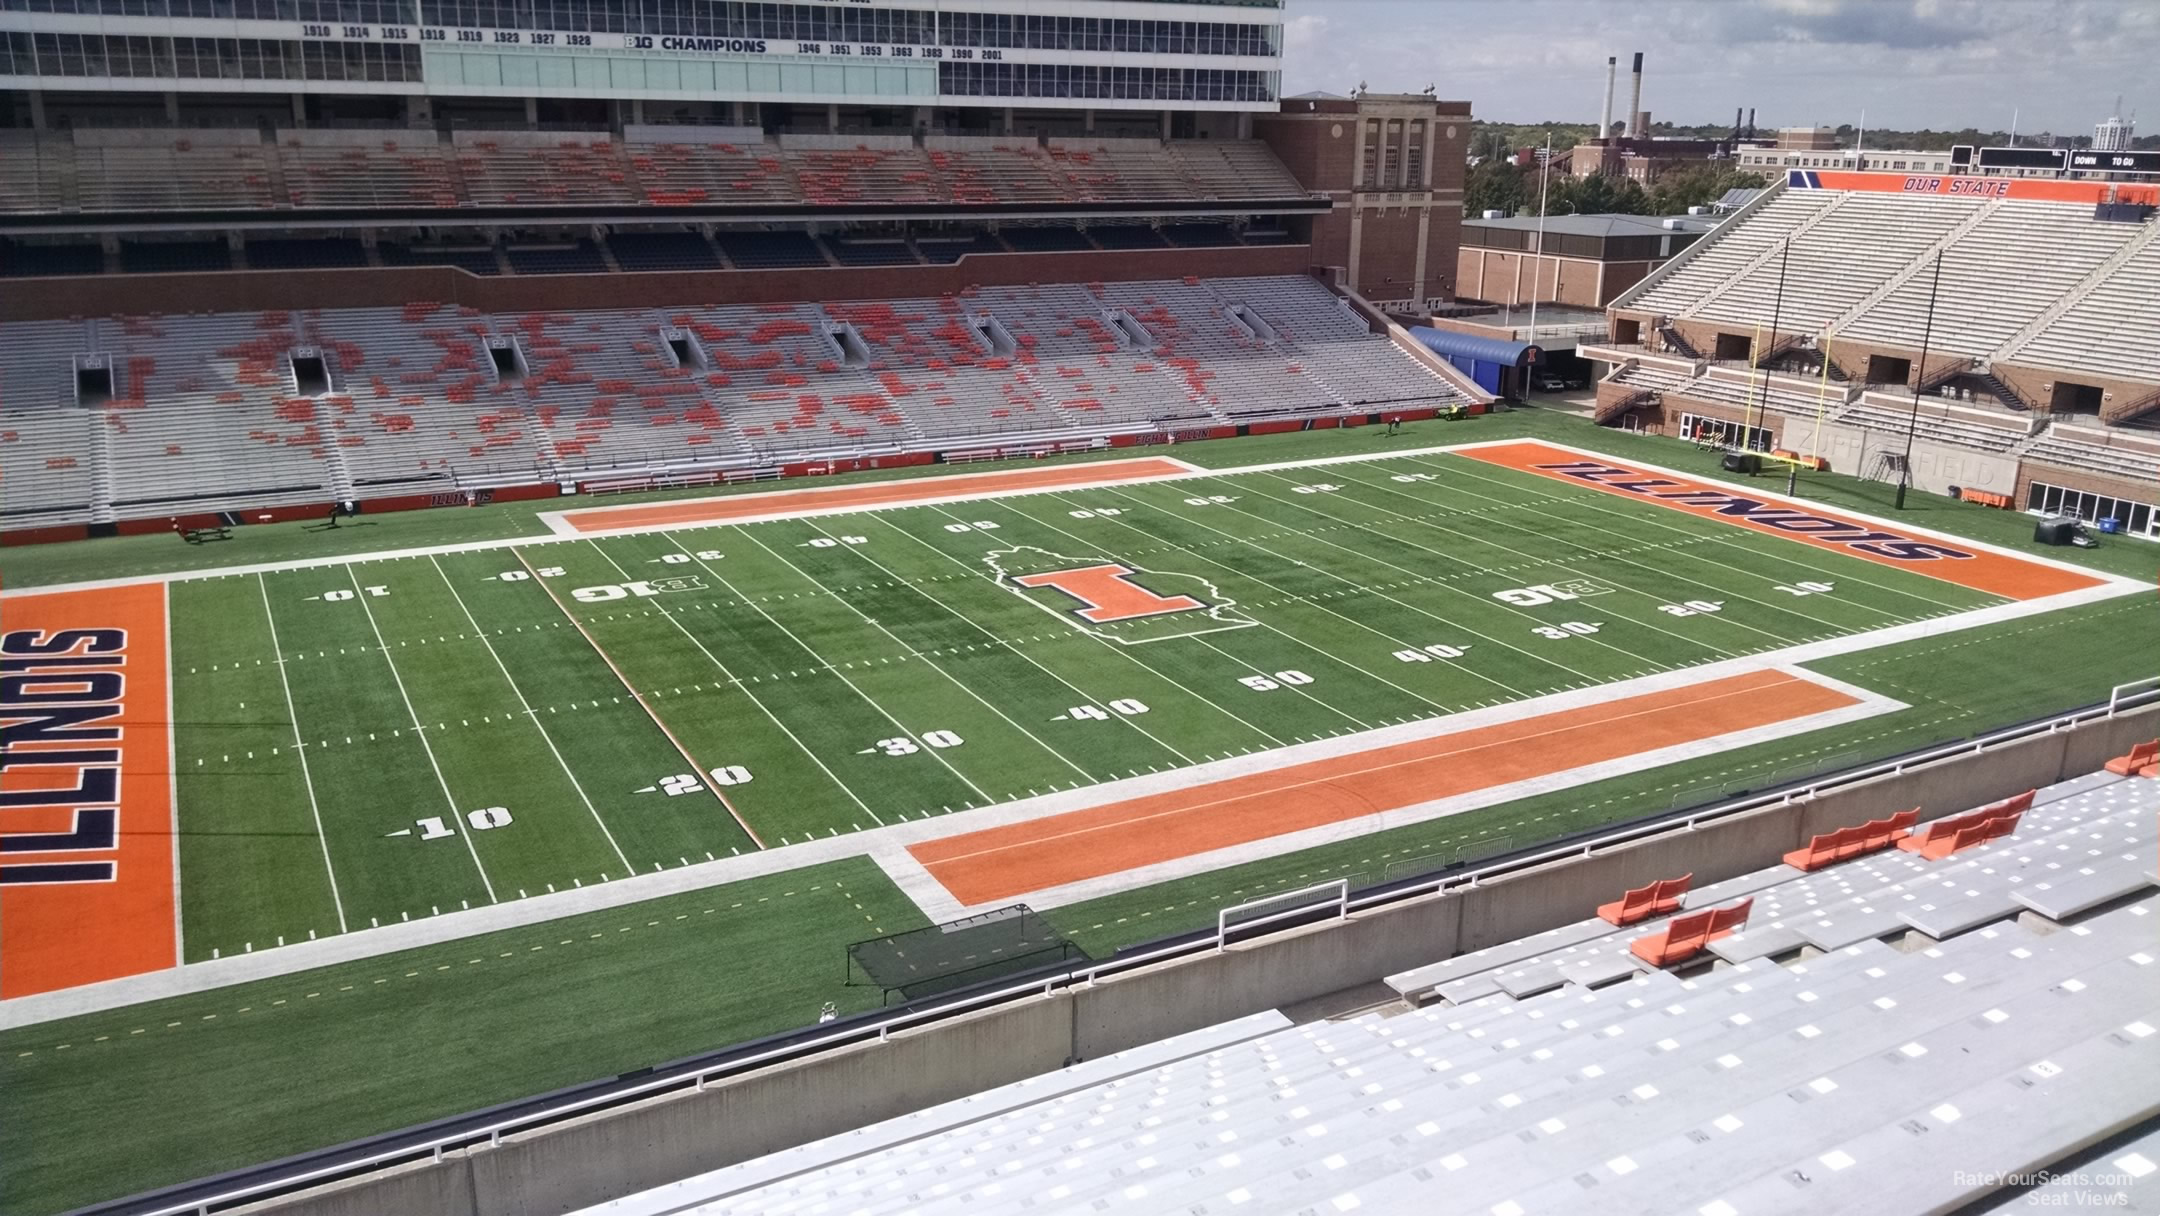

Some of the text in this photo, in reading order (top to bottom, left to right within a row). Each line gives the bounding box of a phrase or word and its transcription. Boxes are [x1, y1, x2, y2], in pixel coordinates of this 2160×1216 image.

[380, 27, 410, 40] 1915
[419, 28, 447, 41] 1918
[530, 32, 556, 45] 1927
[661, 37, 767, 54] CHAMPIONS
[797, 42, 822, 55] 1946
[829, 44, 852, 56] 1951
[859, 45, 883, 57] 1953
[890, 47, 914, 59] 1963
[921, 48, 944, 60] 1983
[981, 50, 1004, 62] 2001
[2074, 156, 2097, 165] DOWN
[2112, 157, 2134, 167] TO GO
[1904, 176, 2011, 197] OUR STATE
[1135, 429, 1213, 445] FIGHTIG ILLINI
[1917, 450, 1996, 487] FIELD
[430, 492, 493, 506] ILLINIS
[1528, 460, 1977, 560] ILLINOIS
[0, 628, 128, 886] ILLINOIS
